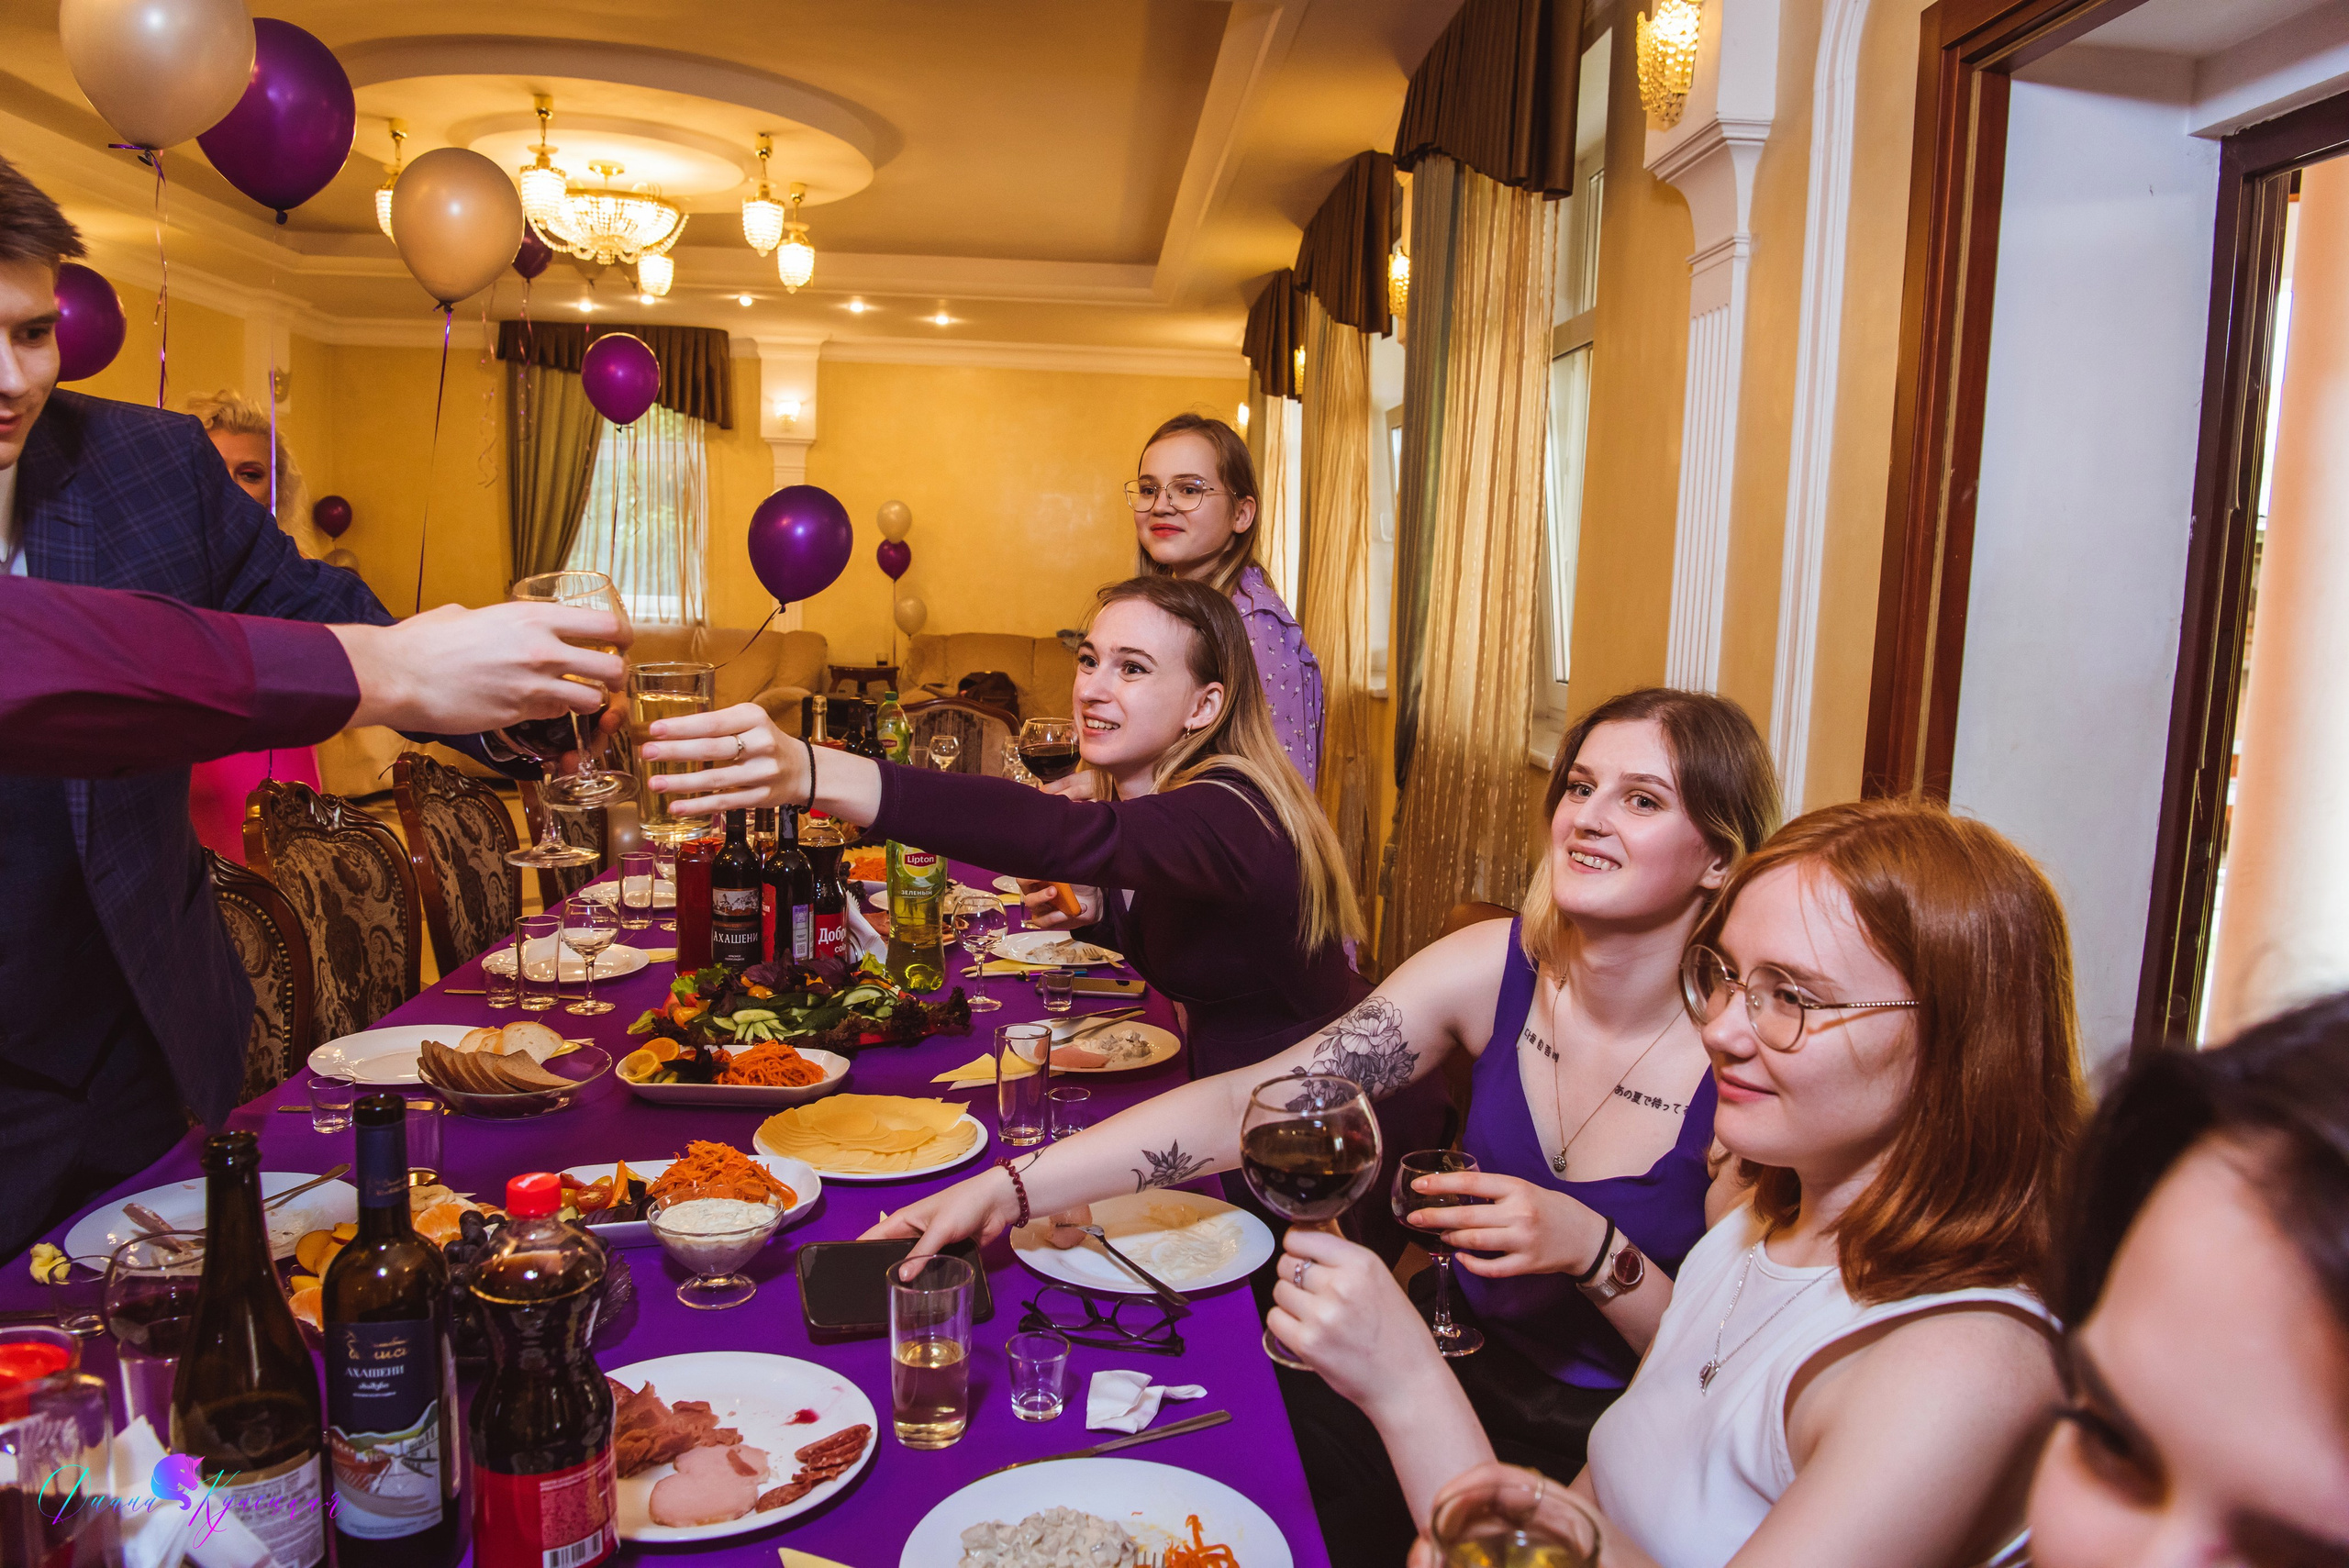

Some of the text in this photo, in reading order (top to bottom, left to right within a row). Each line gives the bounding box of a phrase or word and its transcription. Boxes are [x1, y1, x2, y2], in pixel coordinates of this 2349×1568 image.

[907, 855, 935, 864] Lipton
[713, 930, 758, 944] АХАШЕНИ
[818, 925, 846, 945] Добр
